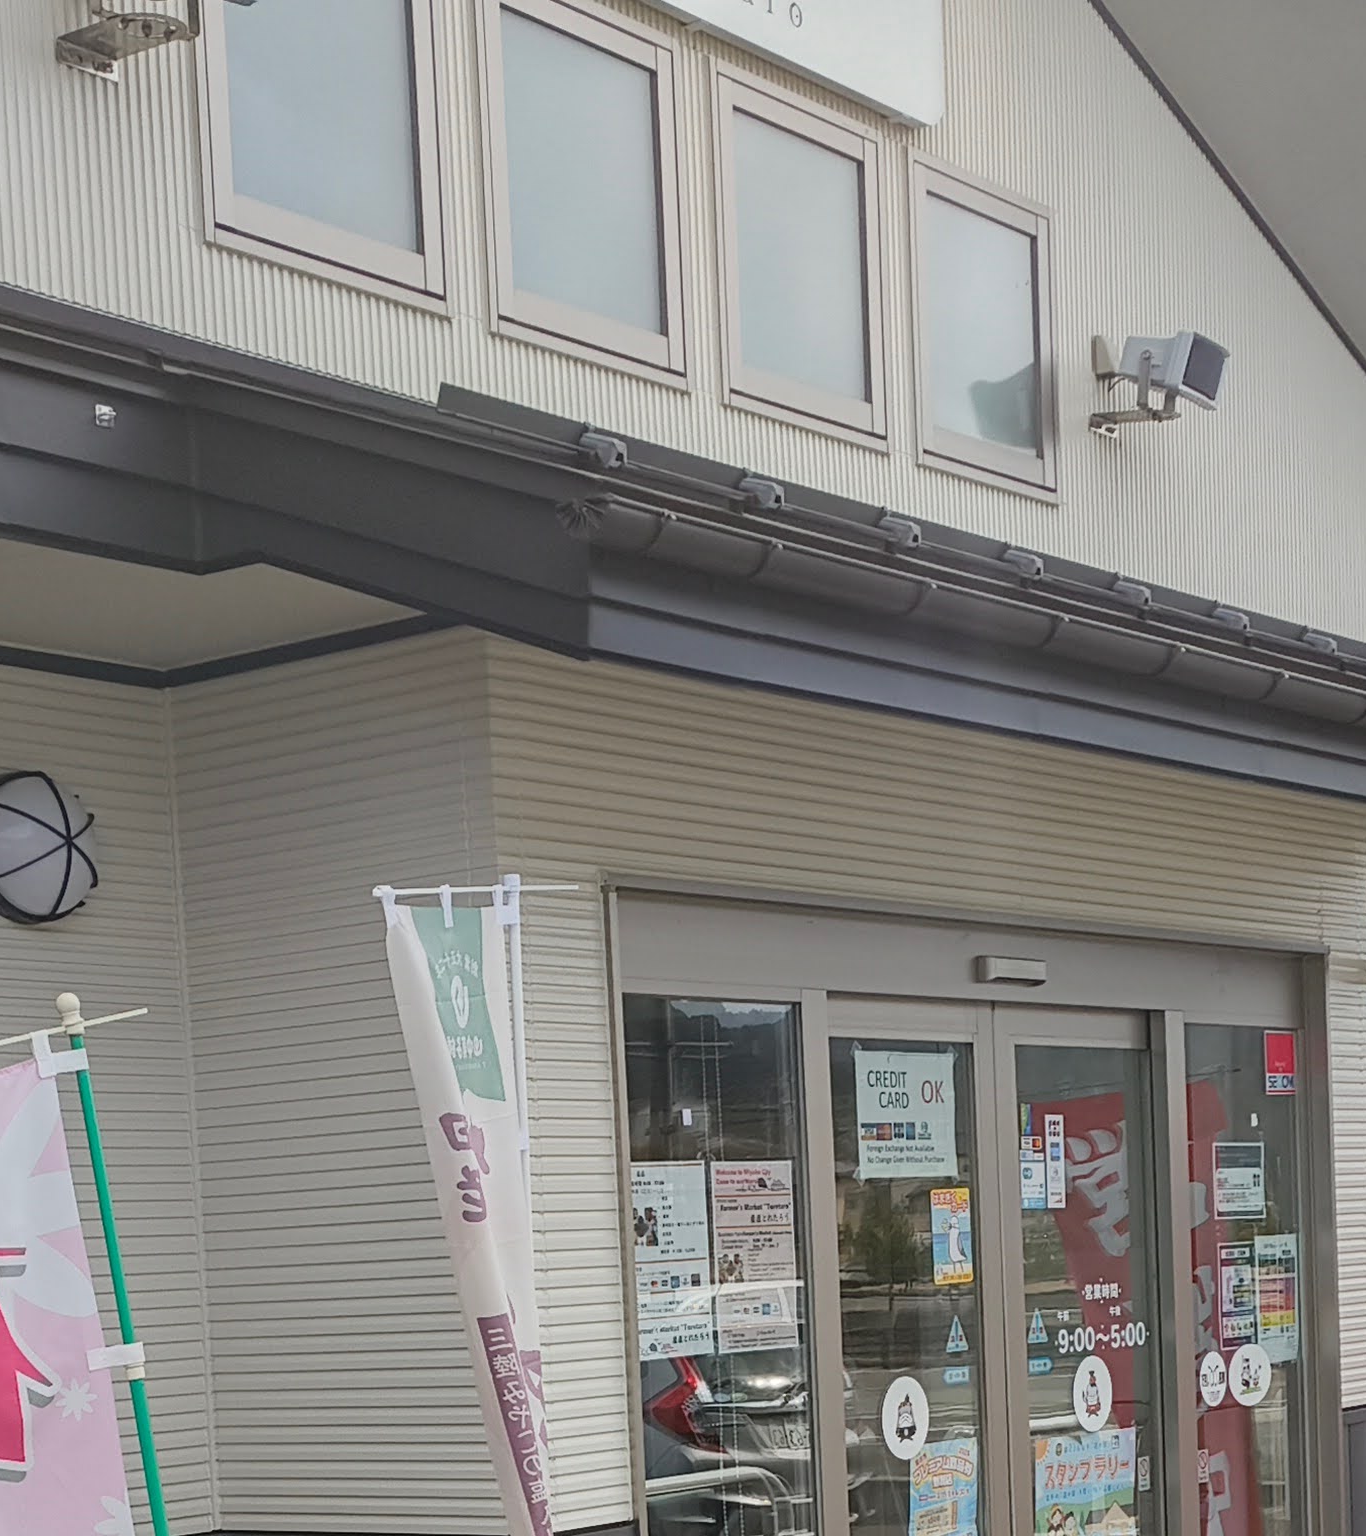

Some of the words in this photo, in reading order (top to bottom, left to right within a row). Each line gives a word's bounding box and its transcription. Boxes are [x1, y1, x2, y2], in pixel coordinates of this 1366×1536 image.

[867, 1070, 907, 1088] CREDIT
[879, 1092, 910, 1109] CARD
[921, 1080, 945, 1104] OK
[1084, 1283, 1119, 1300] 営業時間
[1045, 1454, 1130, 1490] スタンプラリー
